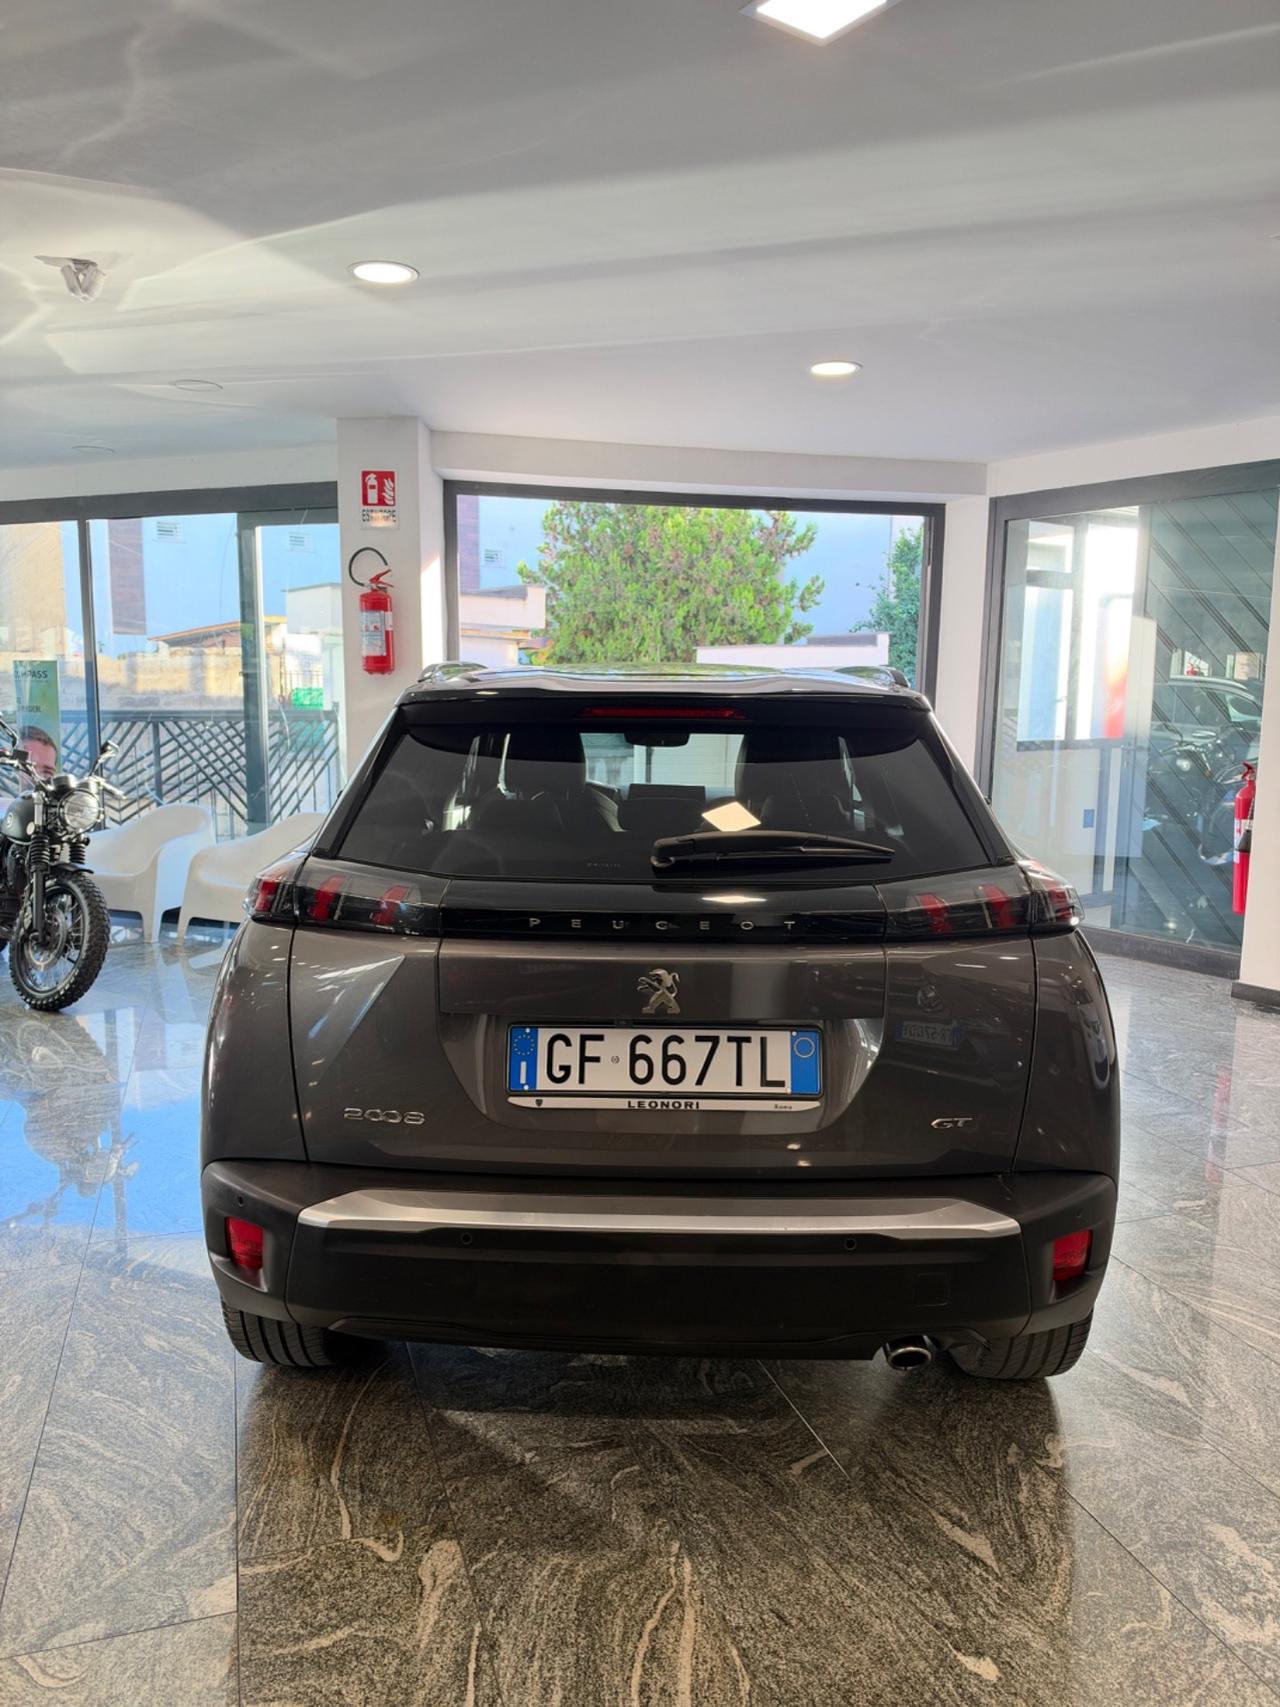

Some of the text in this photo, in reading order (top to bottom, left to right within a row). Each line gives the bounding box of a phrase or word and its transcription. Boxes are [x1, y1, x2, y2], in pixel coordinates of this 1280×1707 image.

[529, 917, 796, 931] PEUGEOT
[546, 1033, 786, 1088] GF 667TL
[627, 1101, 700, 1110] LEONORI
[344, 1107, 426, 1125] 2008
[930, 1117, 974, 1129] GT
